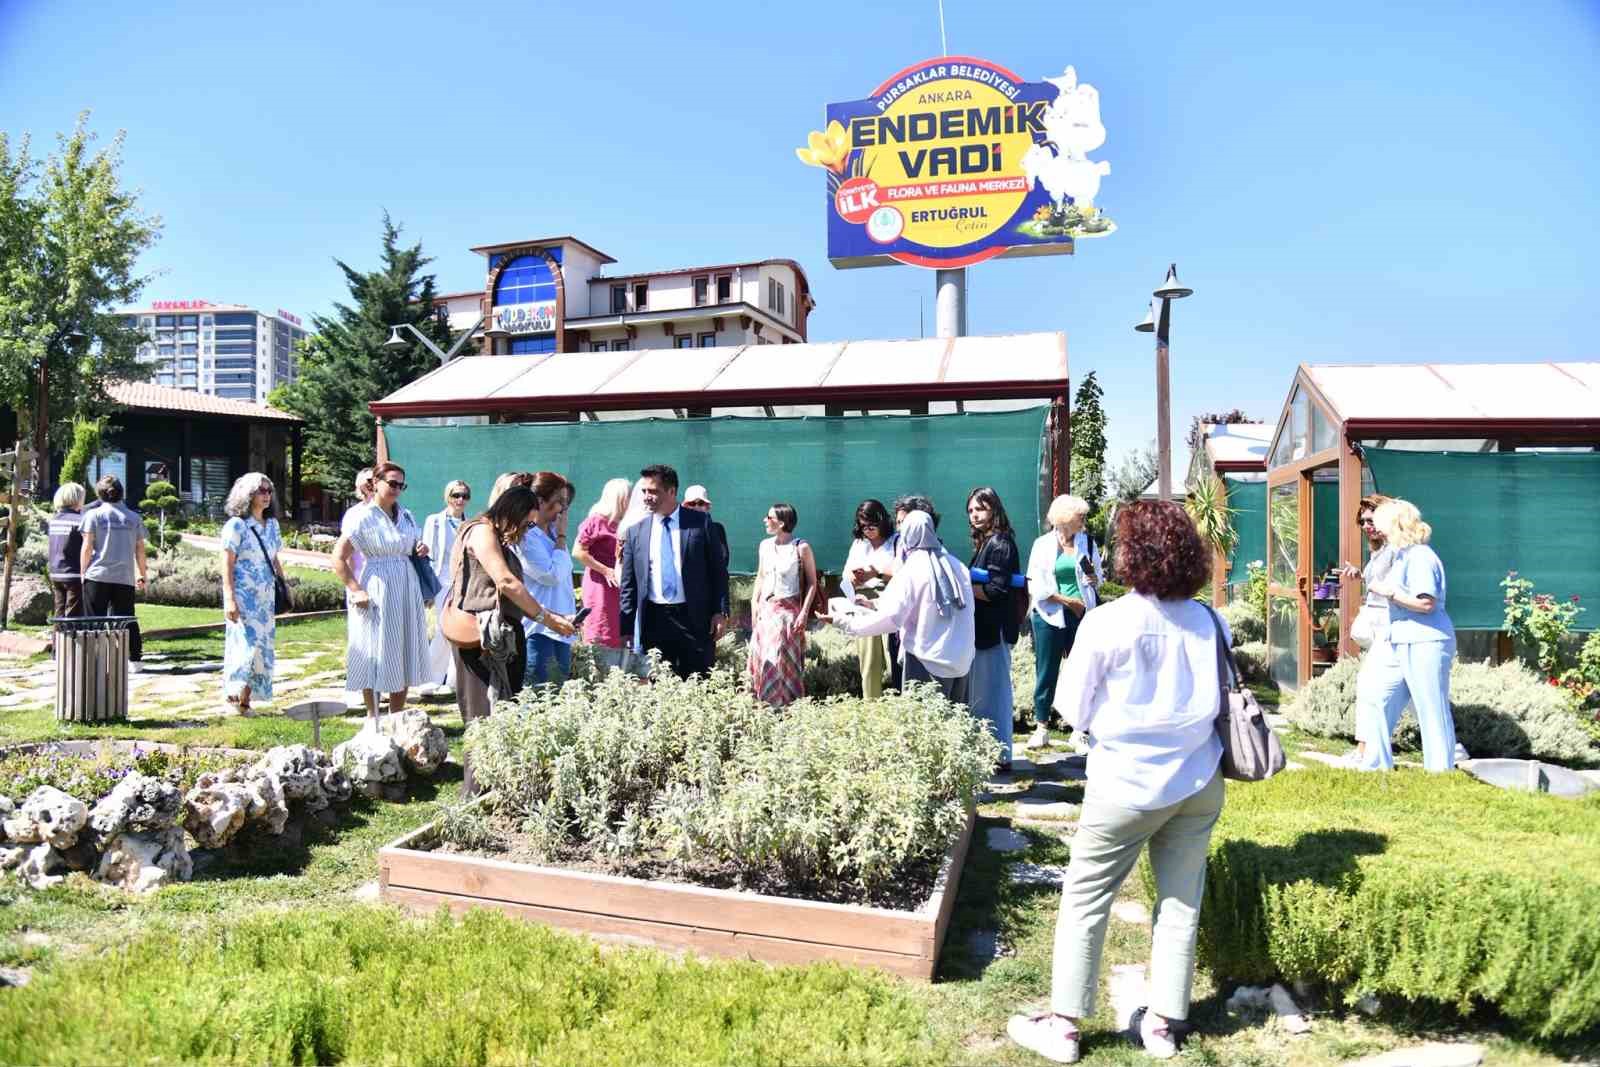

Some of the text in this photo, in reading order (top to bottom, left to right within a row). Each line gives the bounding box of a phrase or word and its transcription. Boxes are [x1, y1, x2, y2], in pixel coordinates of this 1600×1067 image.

[877, 65, 1021, 111] PURSAKLAR BELEDİYESİ
[918, 90, 973, 105] ANKARA
[851, 103, 1047, 148] ENDEMİK
[899, 143, 1002, 178] VADİ
[839, 188, 880, 215] İLK
[888, 188, 922, 199] FLORA
[925, 185, 939, 196] VE
[940, 182, 977, 194] FAUNA
[979, 178, 1025, 192] MERKEZİ
[911, 206, 988, 223] ERTUĞRUL
